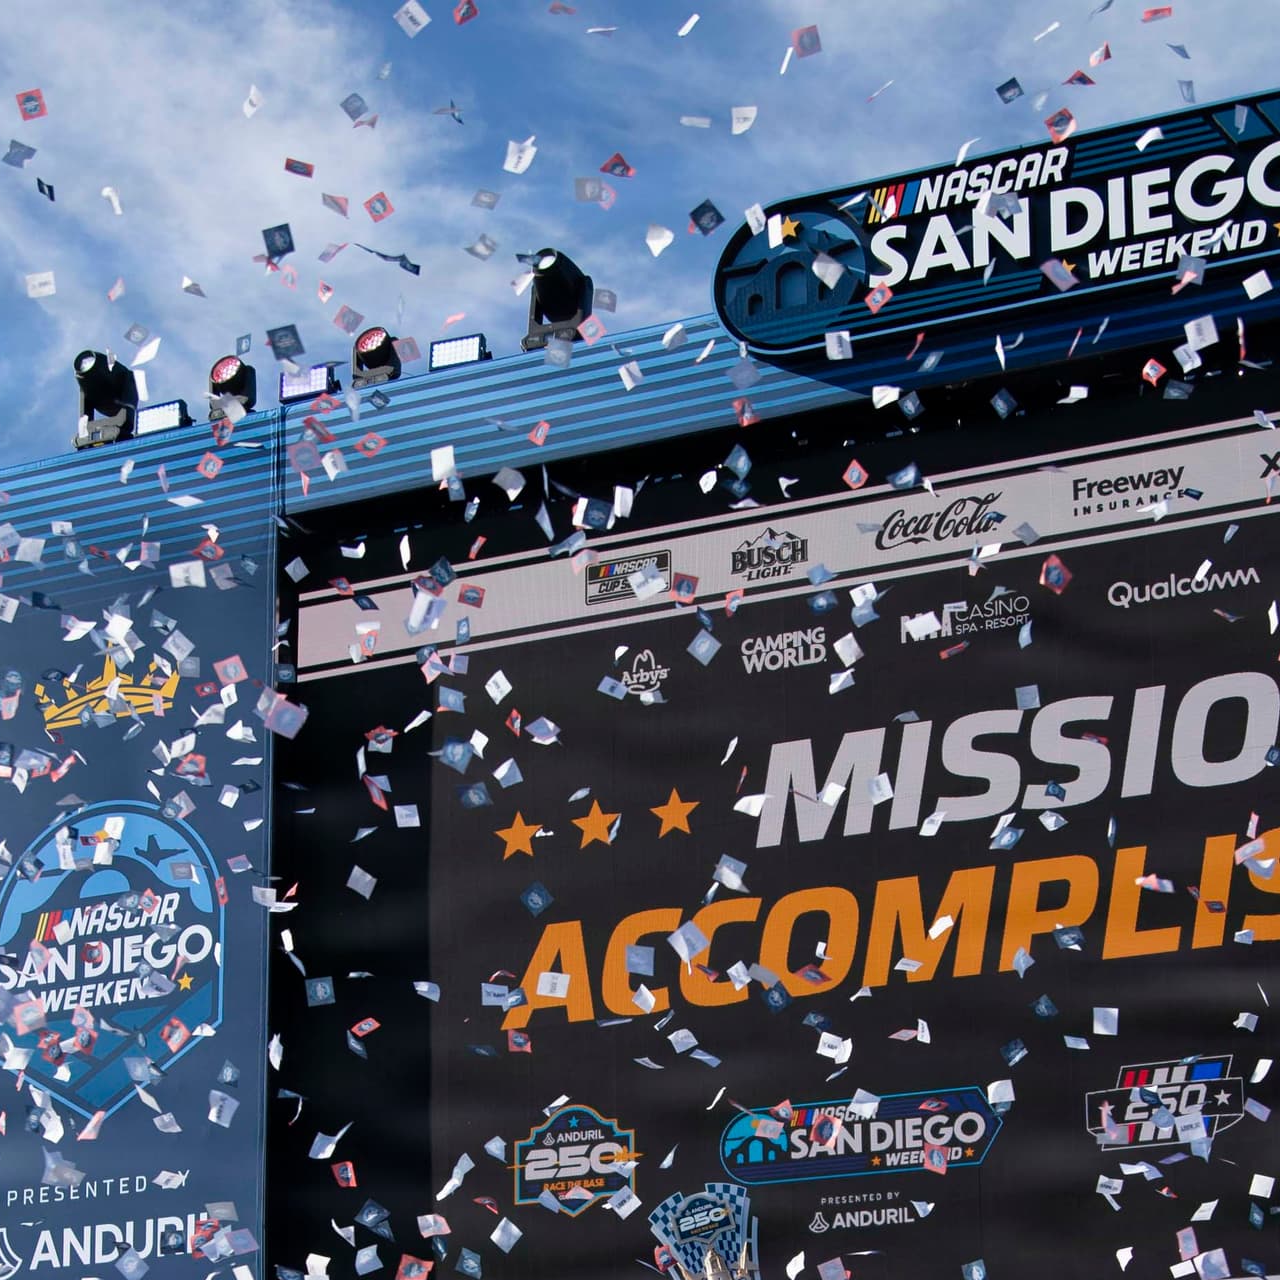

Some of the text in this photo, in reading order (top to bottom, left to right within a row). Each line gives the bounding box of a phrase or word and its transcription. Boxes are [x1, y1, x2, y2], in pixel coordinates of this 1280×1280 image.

[915, 147, 1069, 214] NASCAR
[868, 196, 1032, 289] SAN
[1087, 218, 1267, 279] WEEKEND
[1072, 465, 1184, 501] Freeway
[1073, 489, 1185, 517] INSURANCE
[875, 491, 1003, 550] Coca-Cola
[731, 538, 809, 576] BUSCH
[598, 580, 621, 594] CUP
[747, 564, 792, 582] LIGHT
[1108, 566, 1260, 608] Qualcomm
[955, 595, 1030, 622] CASINO
[955, 622, 978, 636] SPA
[985, 613, 1030, 631] RESORT
[741, 626, 826, 656] CAMPING
[621, 667, 668, 686] Arby's
[83, 924, 213, 978] DIEGO
[40, 977, 172, 1013] WEEKEN
[556, 1129, 605, 1144] ANDURIL
[871, 1112, 986, 1151] DIEGO
[524, 1141, 625, 1182] 250
[886, 1147, 963, 1167] WEEKD
[7, 1175, 148, 1207] PRESENTED
[543, 1181, 567, 1193] RACE
[584, 1177, 606, 1189] BASE
[821, 1191, 900, 1206] PRESENTED BY
[678, 1206, 727, 1233] 250
[832, 1208, 915, 1230] ANDURIL
